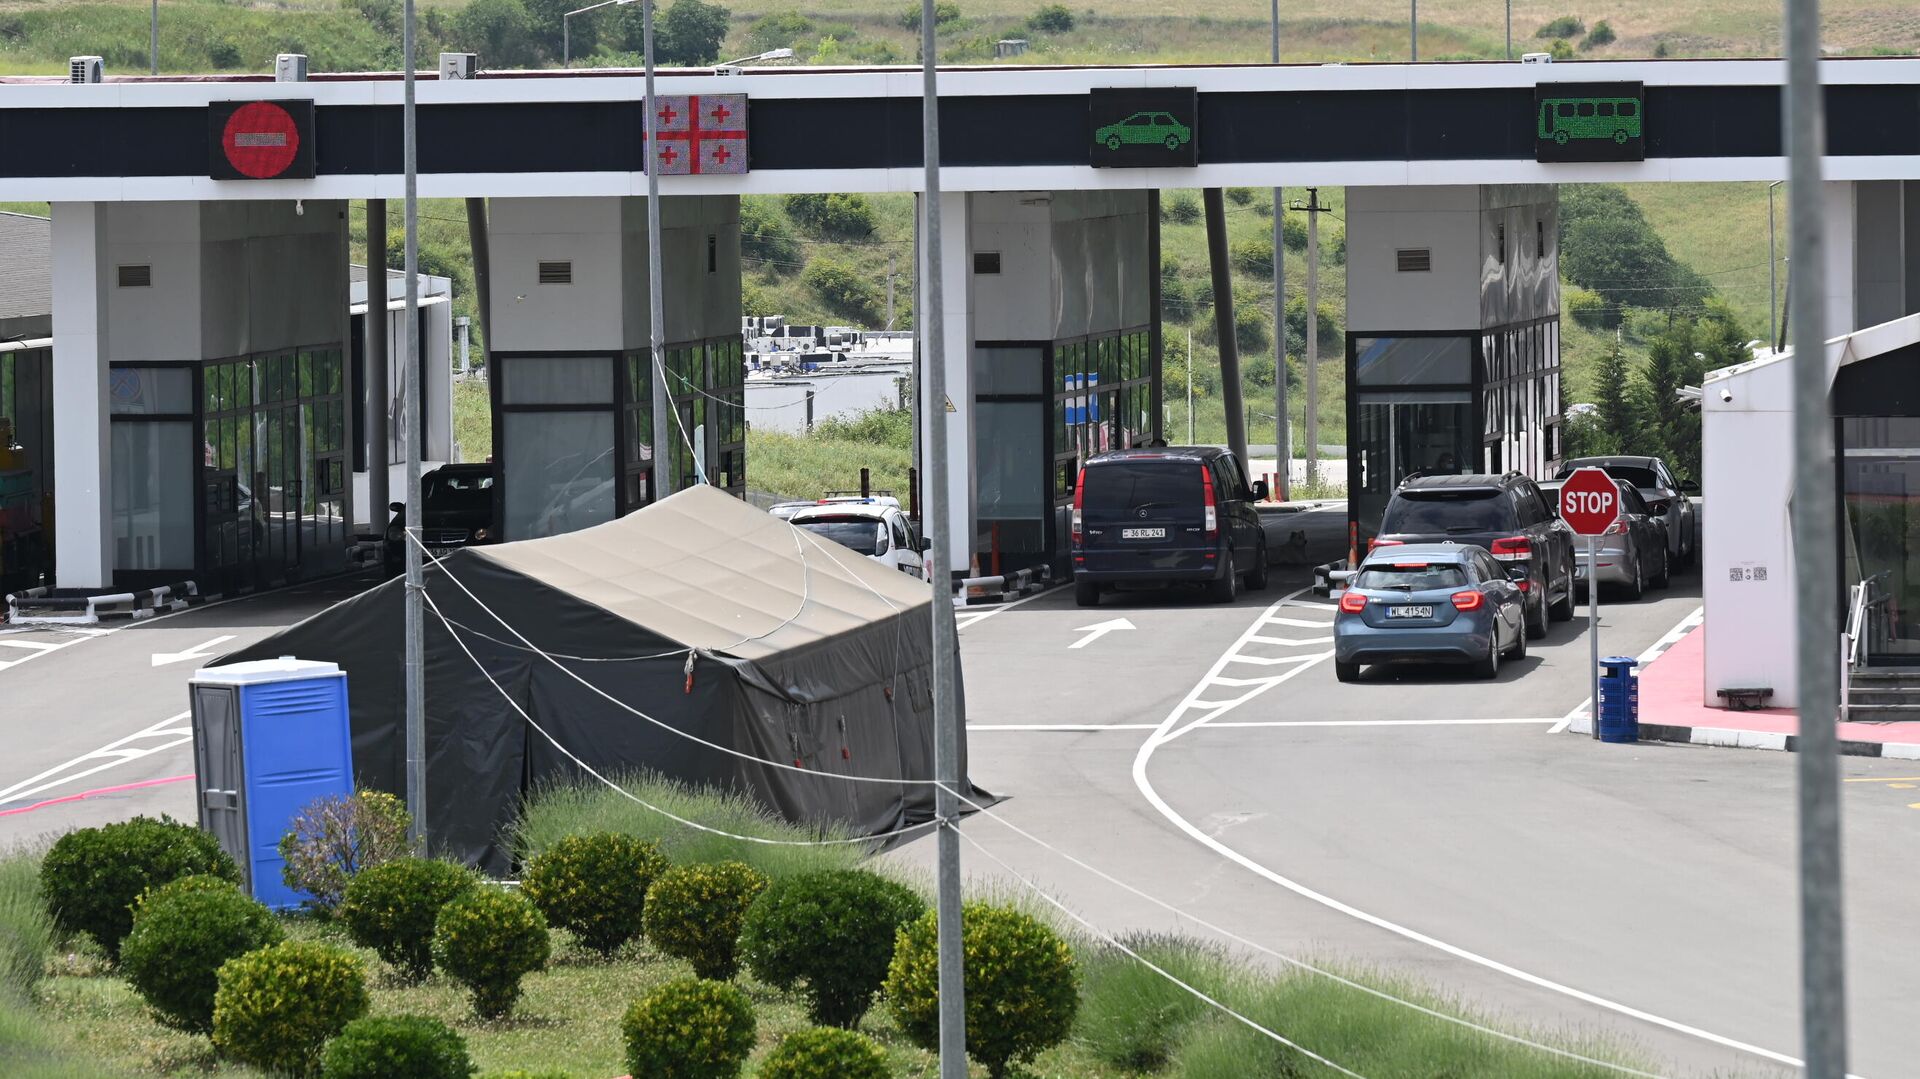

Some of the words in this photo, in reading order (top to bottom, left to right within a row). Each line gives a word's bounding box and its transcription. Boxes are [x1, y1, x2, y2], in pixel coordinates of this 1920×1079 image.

[1566, 491, 1613, 514] STOP
[1140, 529, 1150, 537] RL
[1151, 529, 1163, 537] 241
[1391, 607, 1402, 616] WL
[1405, 606, 1431, 616] 4154N
